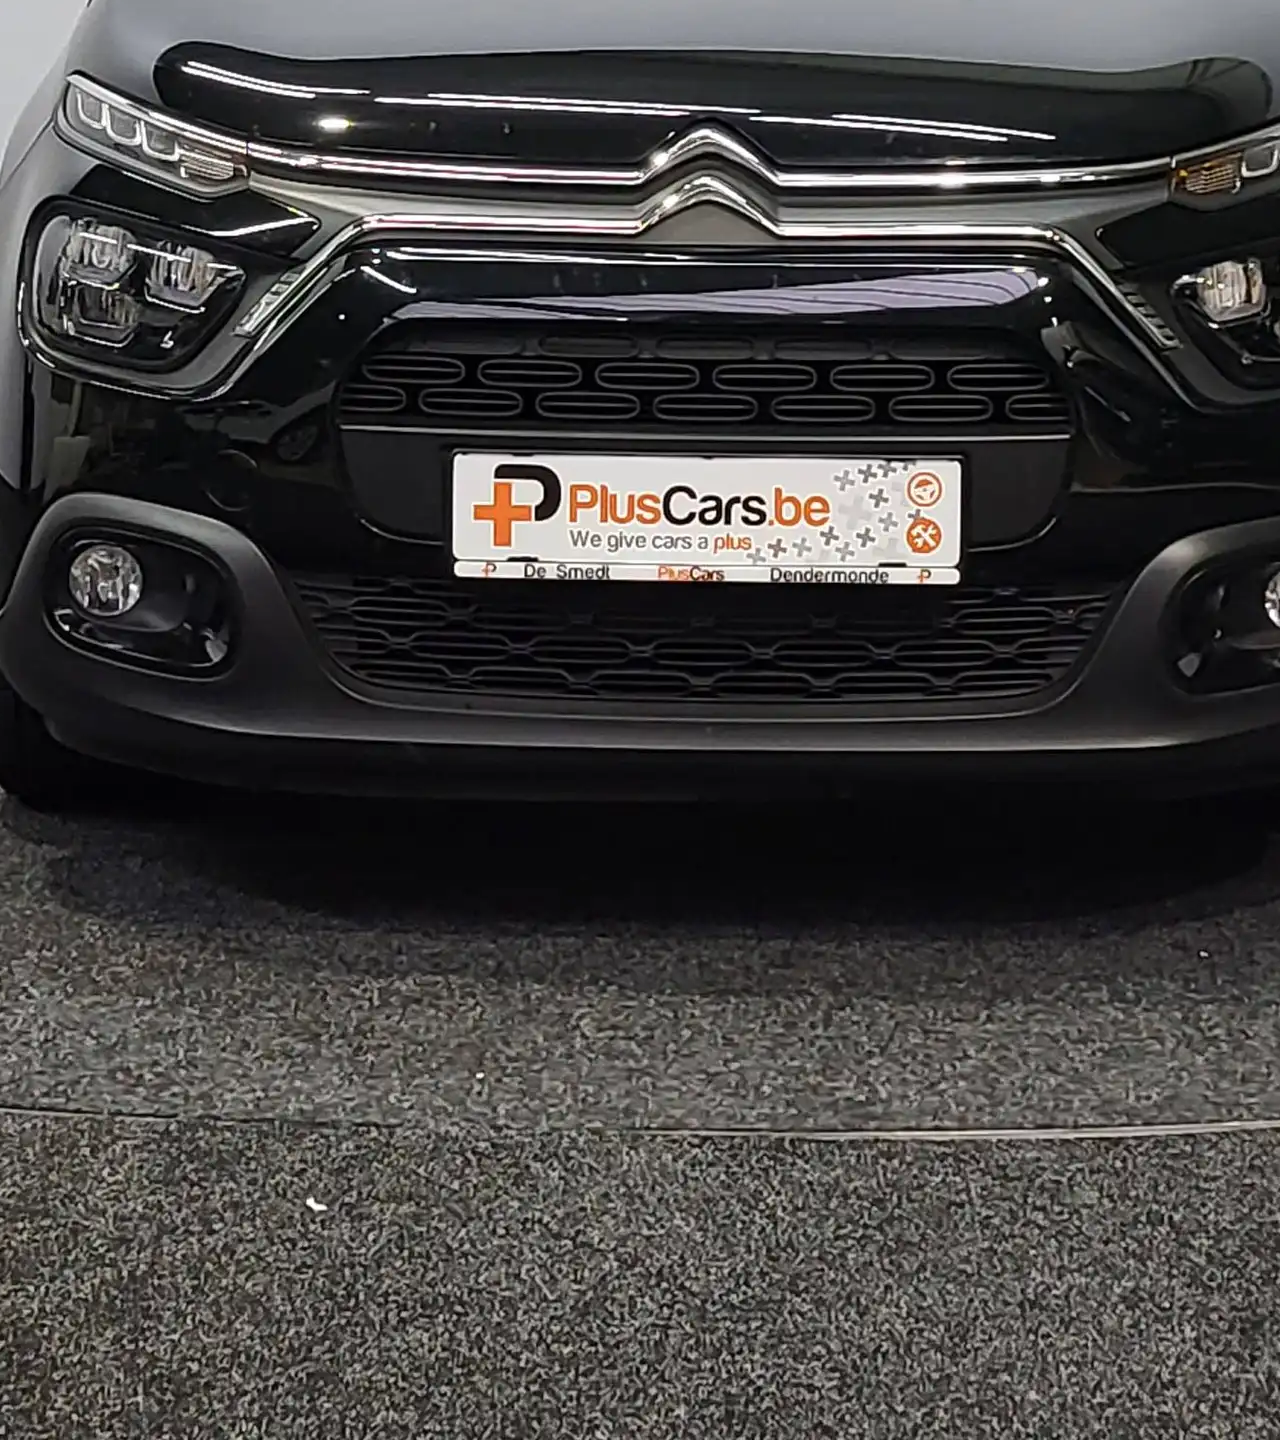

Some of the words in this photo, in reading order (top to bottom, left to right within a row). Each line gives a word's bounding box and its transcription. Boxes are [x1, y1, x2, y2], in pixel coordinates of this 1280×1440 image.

[569, 484, 830, 527] PlusCars.be
[570, 530, 603, 548] We
[607, 530, 647, 552] give
[653, 535, 694, 549] cars
[698, 537, 709, 550] a
[714, 533, 752, 554] plus
[524, 564, 547, 579] De
[557, 564, 610, 580] Smedt
[658, 566, 725, 581] PlusCars
[770, 568, 889, 584] Dendermonde
